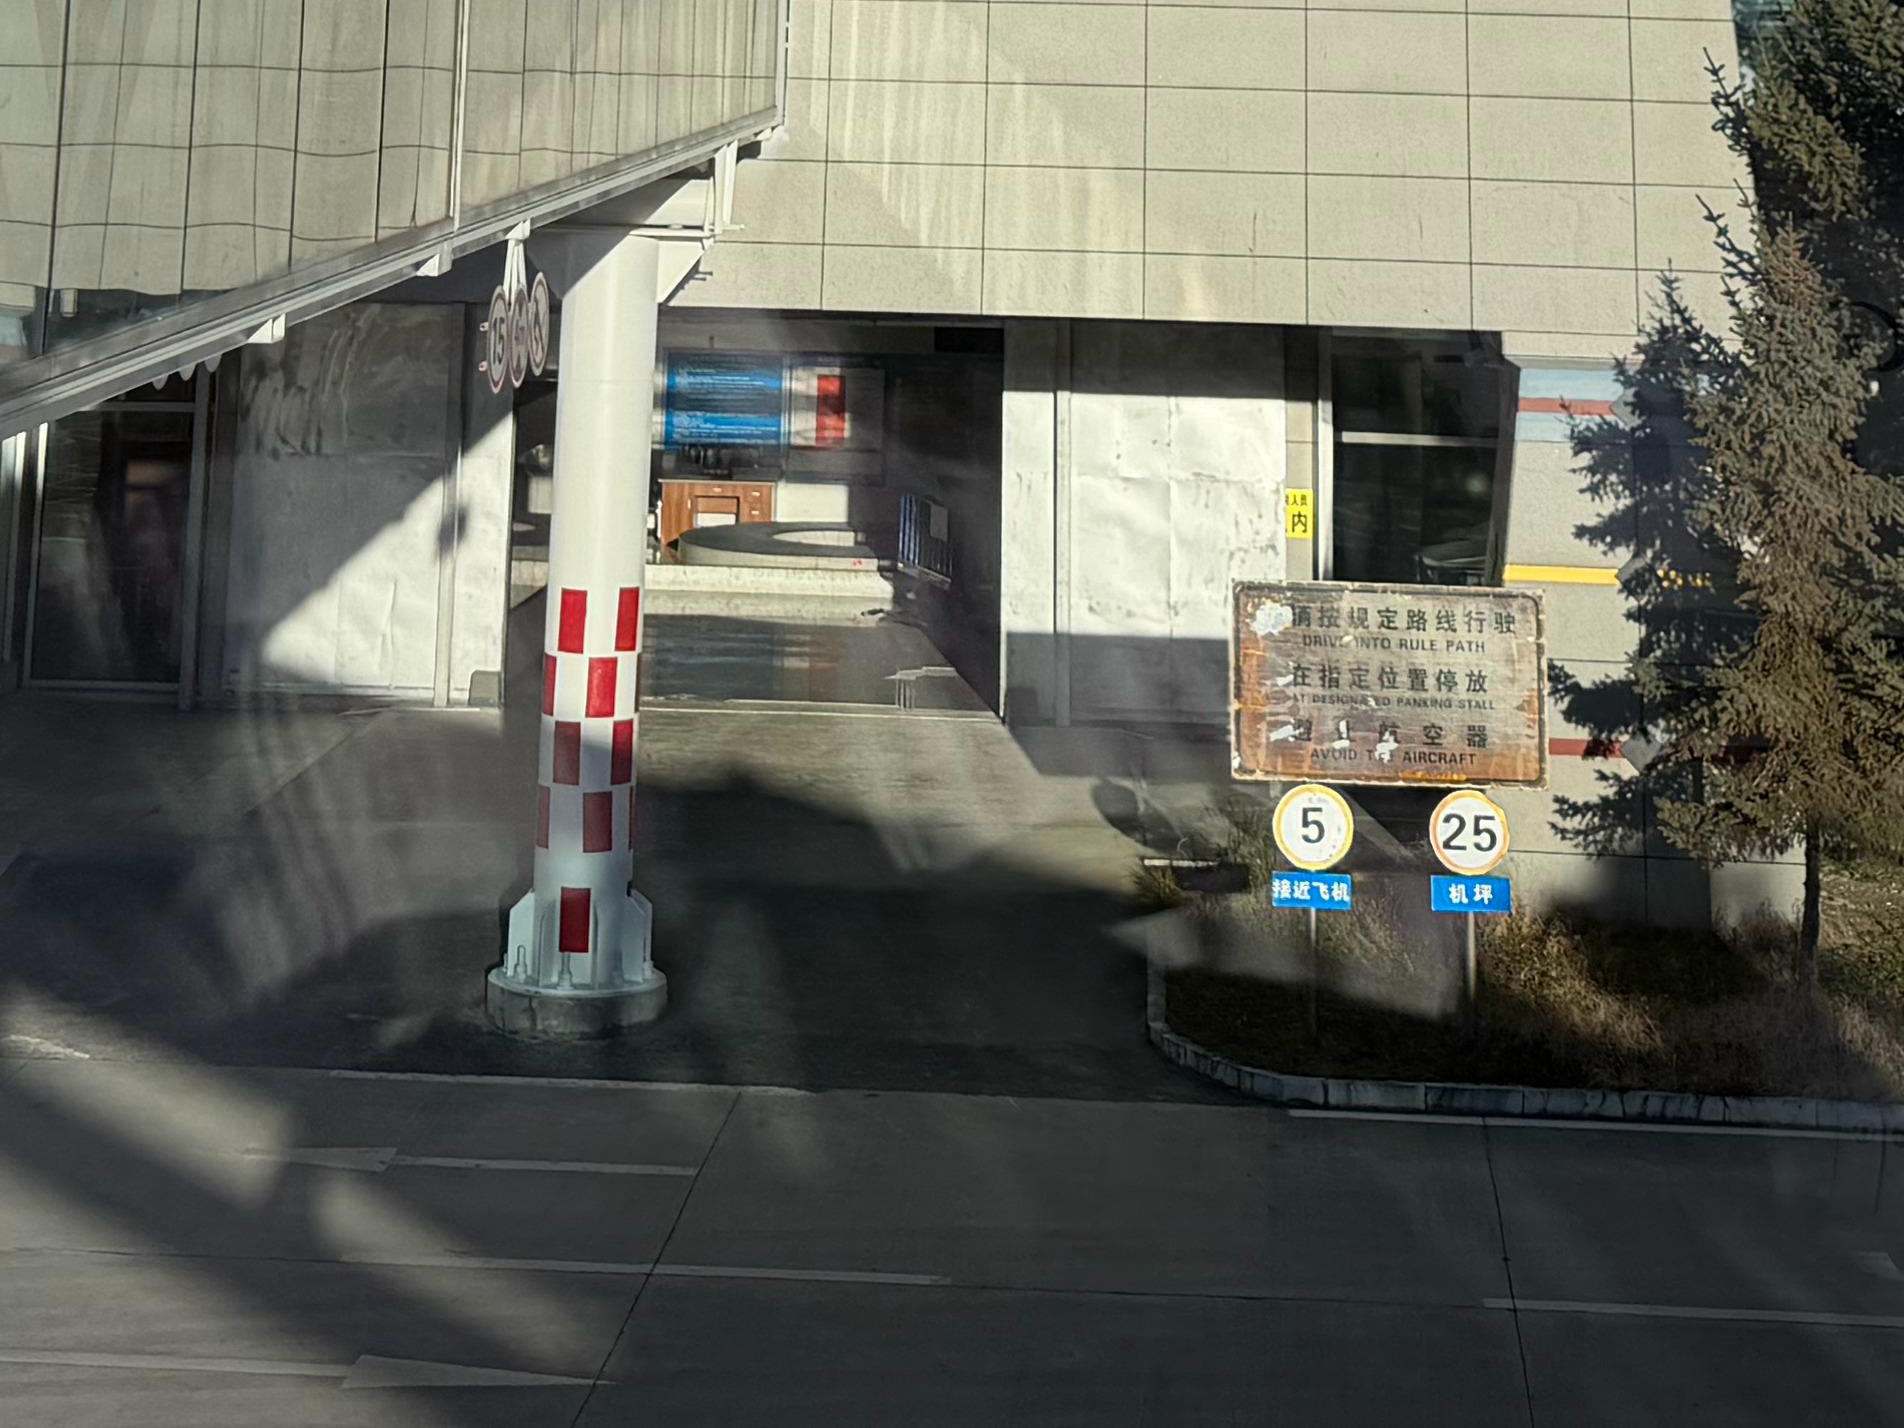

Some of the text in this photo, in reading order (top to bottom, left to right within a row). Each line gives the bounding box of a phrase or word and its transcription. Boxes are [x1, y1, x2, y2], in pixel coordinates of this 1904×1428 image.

[1399, 638, 1438, 652] RULE
[1445, 640, 1486, 654] PATH
[1292, 662, 1489, 694] 在指定位置停放
[1458, 698, 1496, 712] STALL
[1310, 746, 1358, 760] AVOID
[1401, 750, 1477, 765] AIRCRAFT
[1300, 806, 1326, 844] 5
[1441, 813, 1497, 852] 25
[1271, 878, 1351, 903] 接近飞机
[1447, 883, 1494, 905] 机坪
